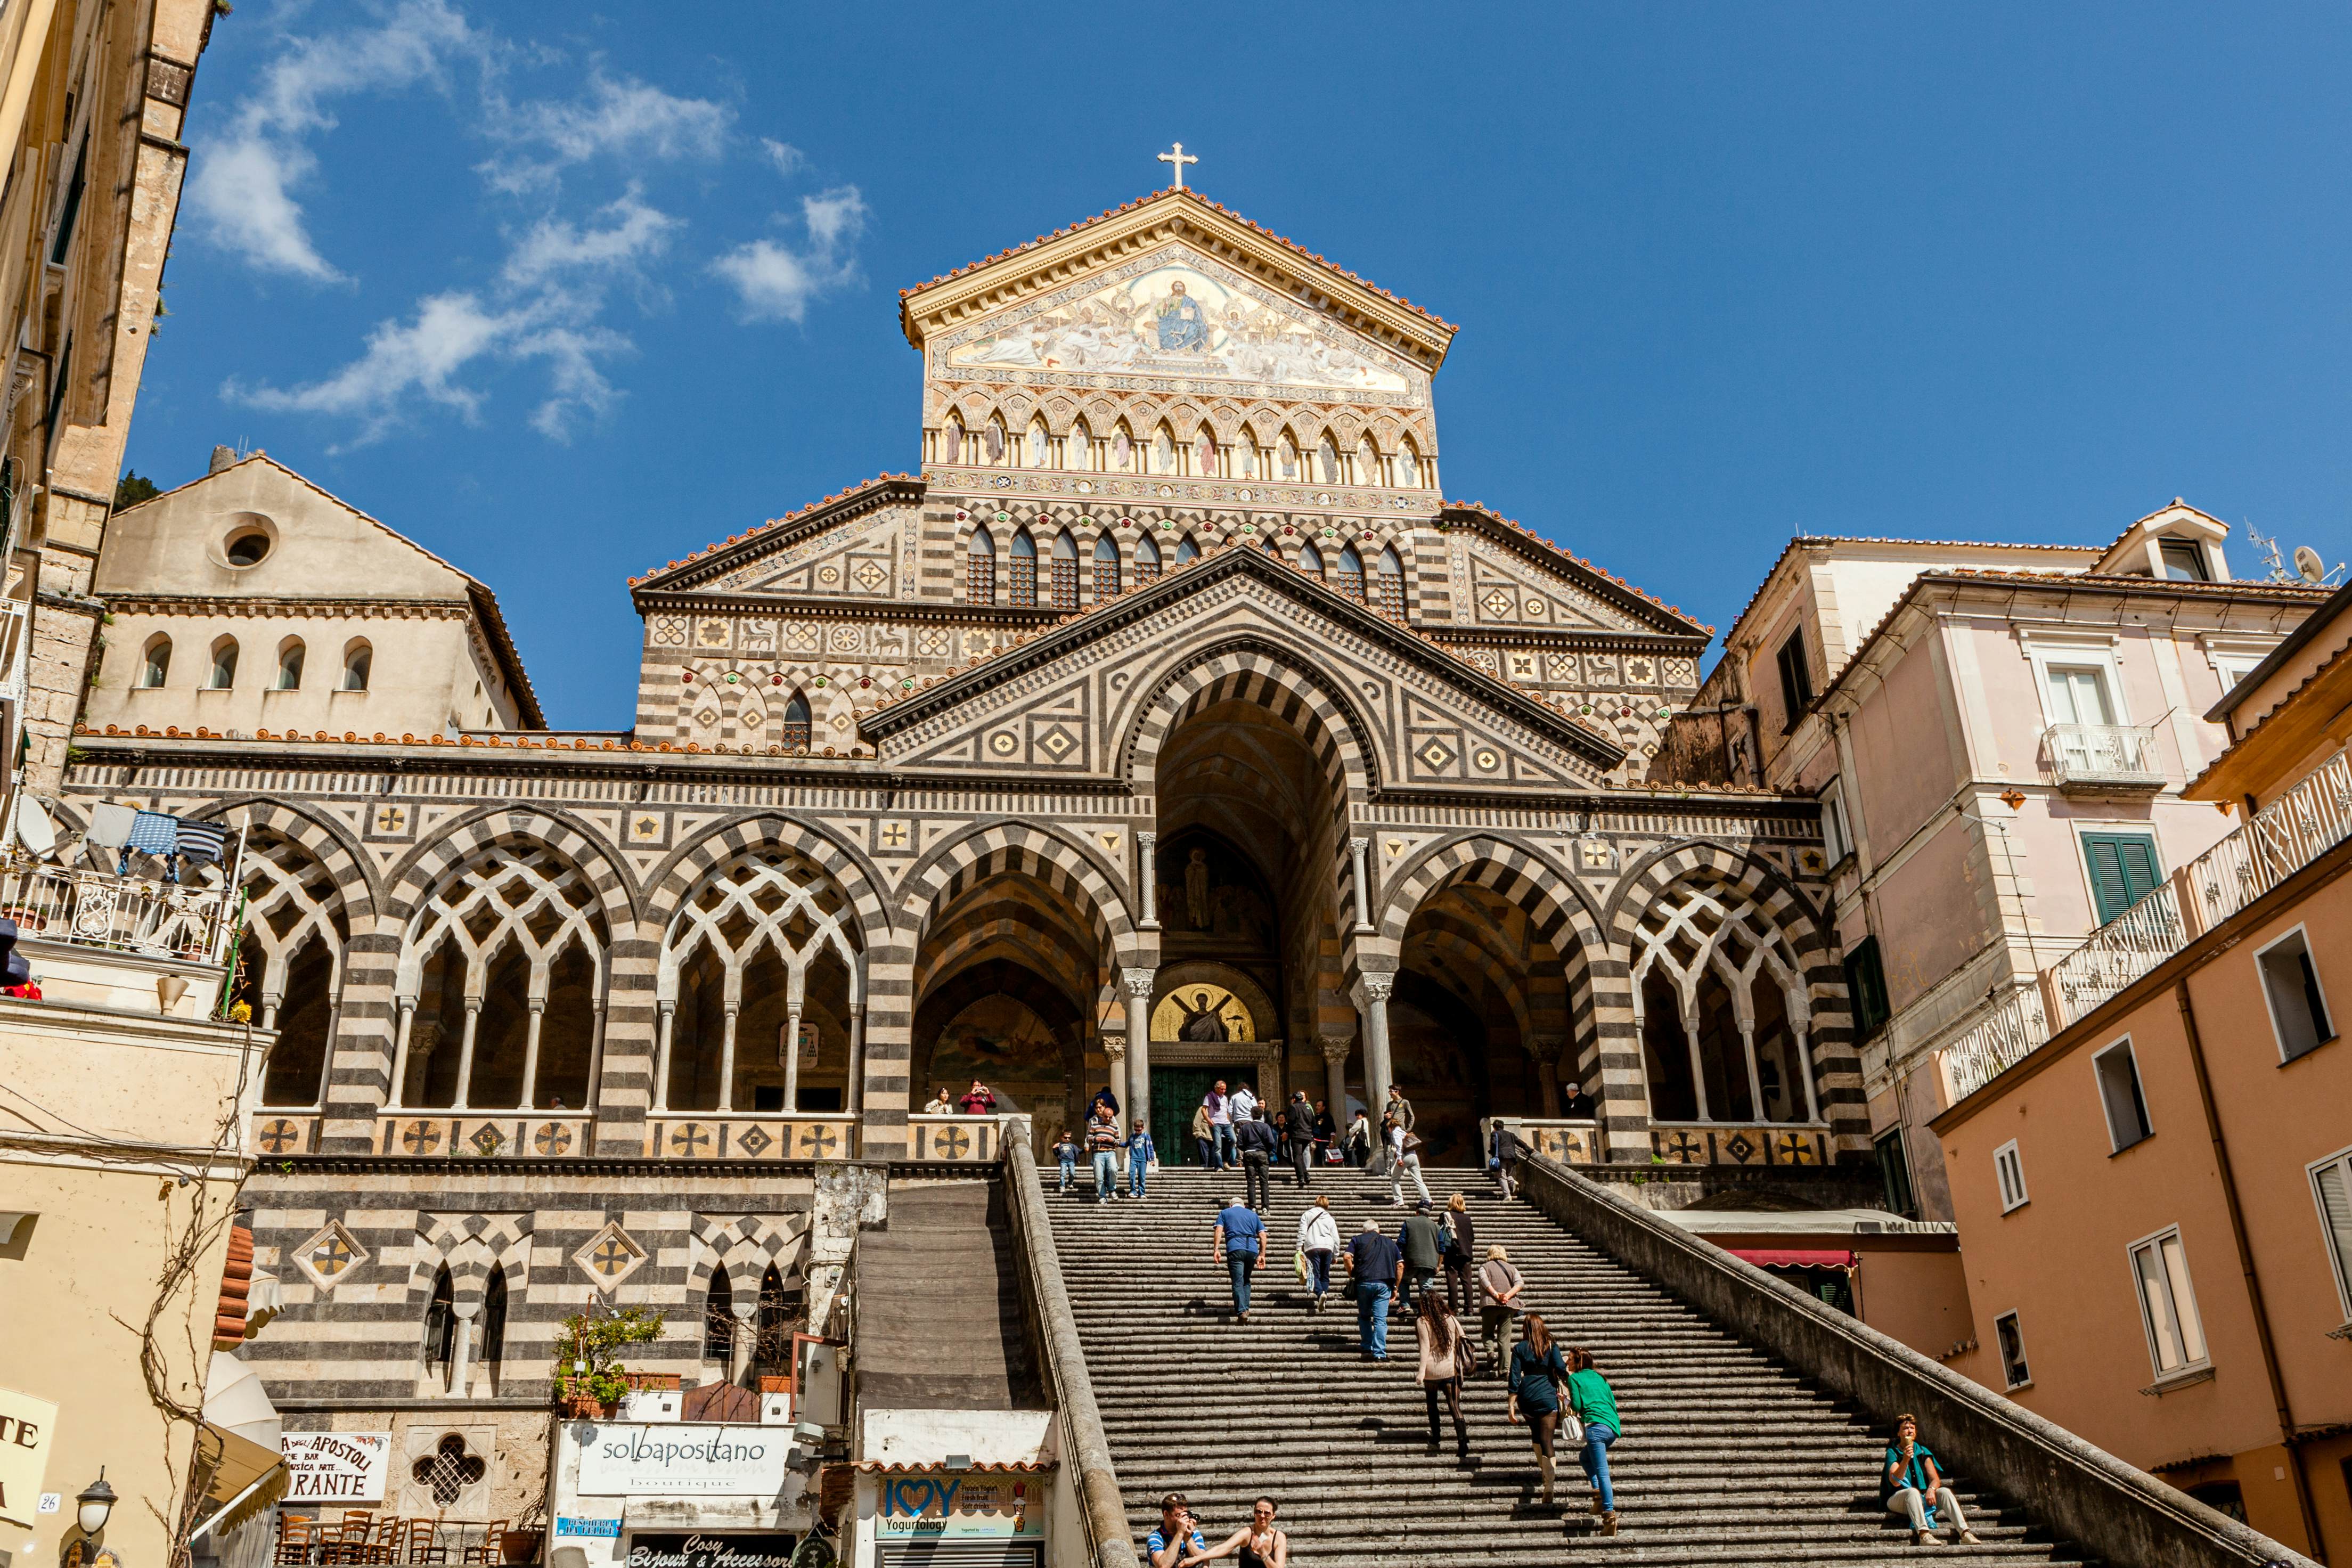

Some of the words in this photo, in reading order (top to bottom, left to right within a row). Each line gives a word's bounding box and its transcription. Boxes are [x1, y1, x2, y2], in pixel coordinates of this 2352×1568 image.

[311, 1436, 372, 1472] APOSTOLI
[289, 1474, 368, 1497] RANTE
[631, 1478, 736, 1489] boutique
[980, 1485, 998, 1493] Yogurt
[41, 1495, 56, 1509] 26
[582, 1526, 614, 1535] FELICE
[886, 1518, 948, 1533] Yogurtology
[683, 1533, 725, 1556] Cosy
[630, 1546, 689, 1568] Bijoux
[696, 1555, 707, 1567] &
